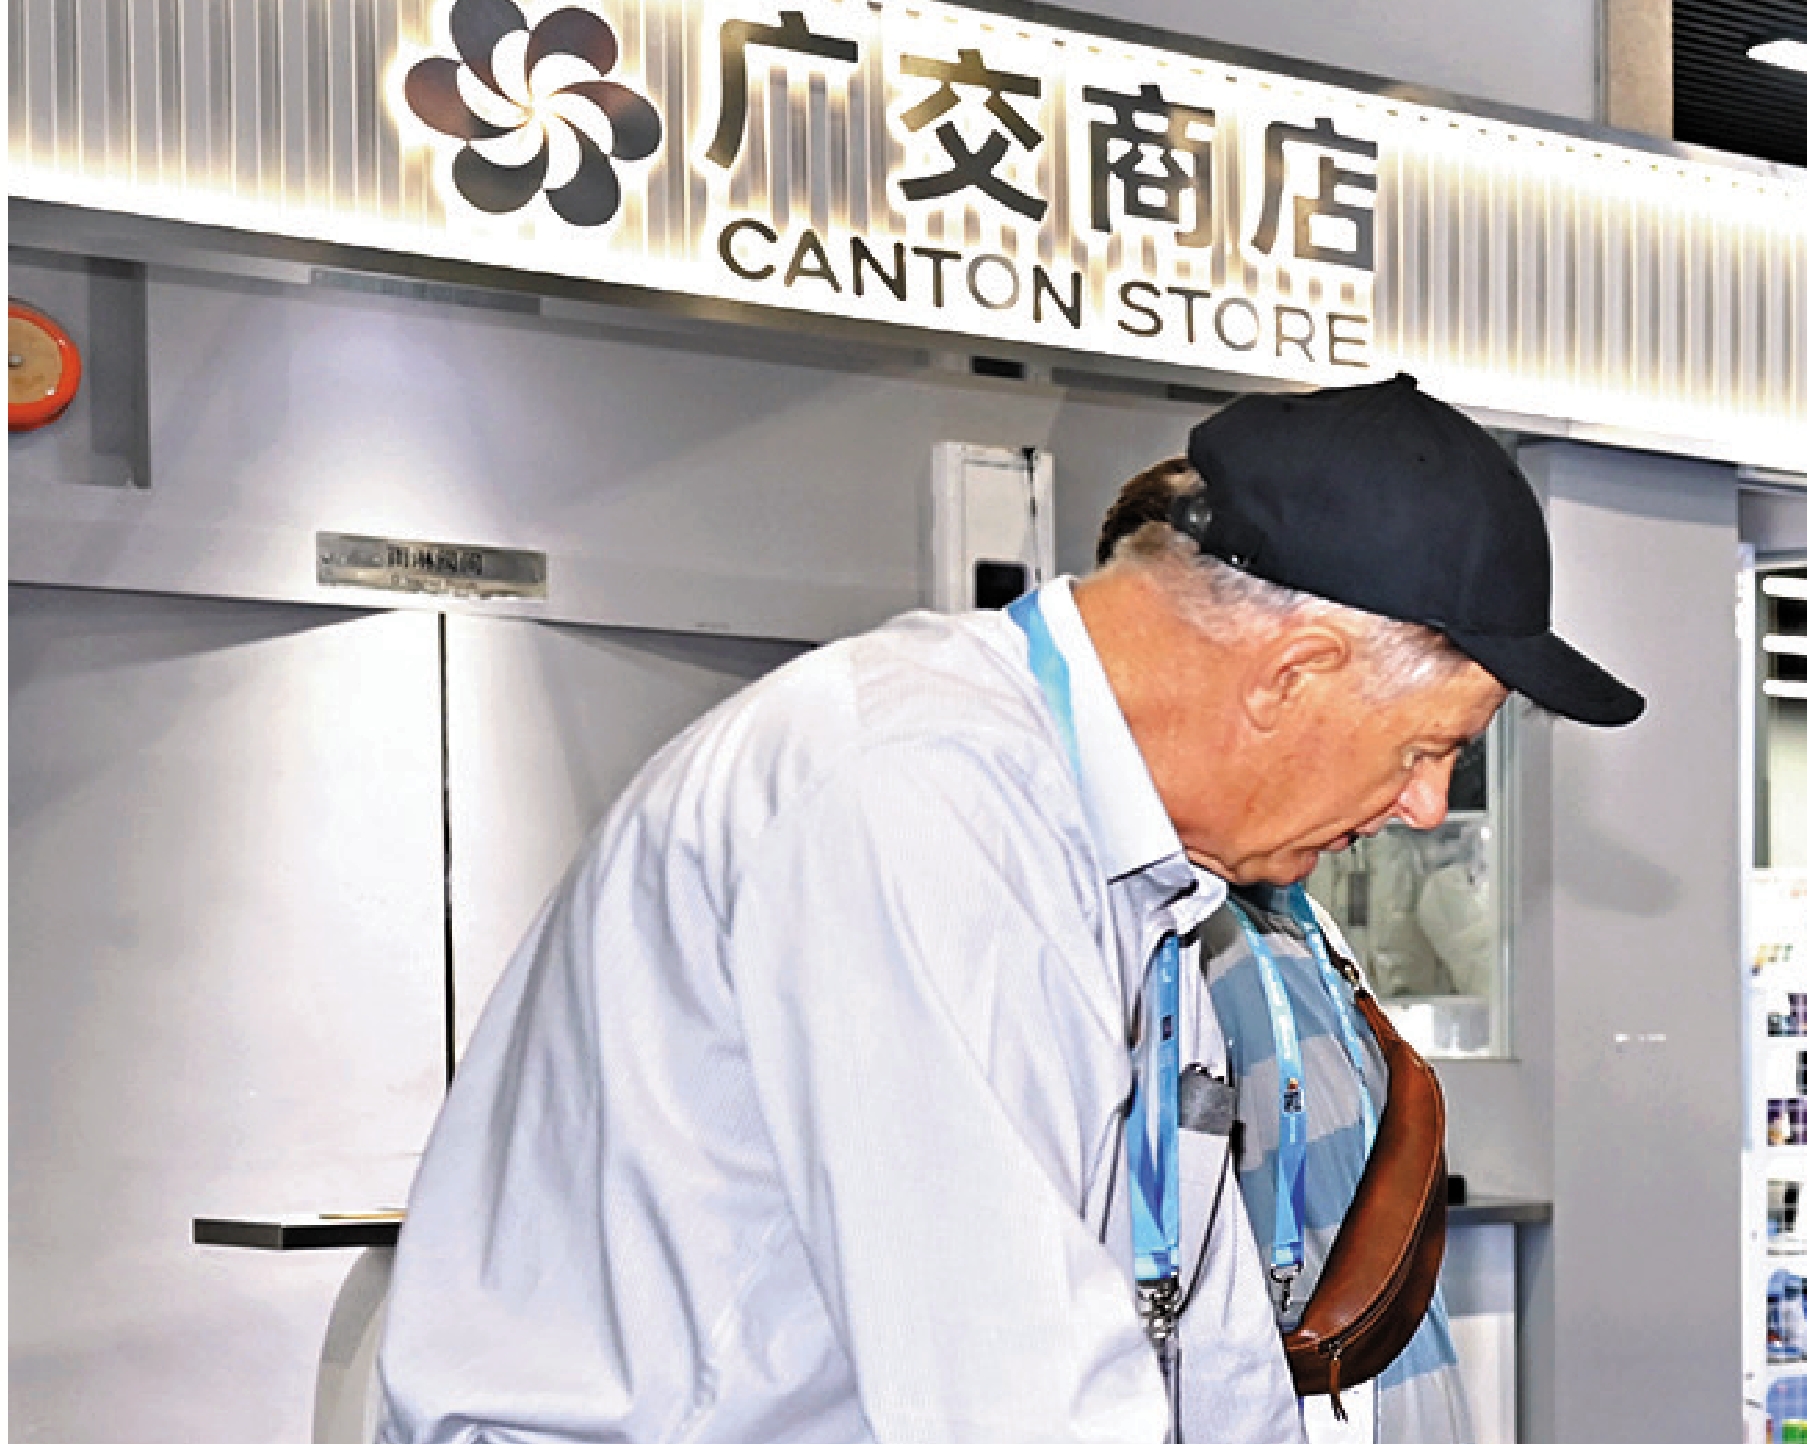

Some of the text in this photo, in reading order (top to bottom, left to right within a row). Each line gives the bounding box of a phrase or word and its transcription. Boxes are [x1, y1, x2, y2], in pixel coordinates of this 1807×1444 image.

[705, 11, 1378, 271] 广交商店
[716, 218, 1370, 368] CANTON STORE
